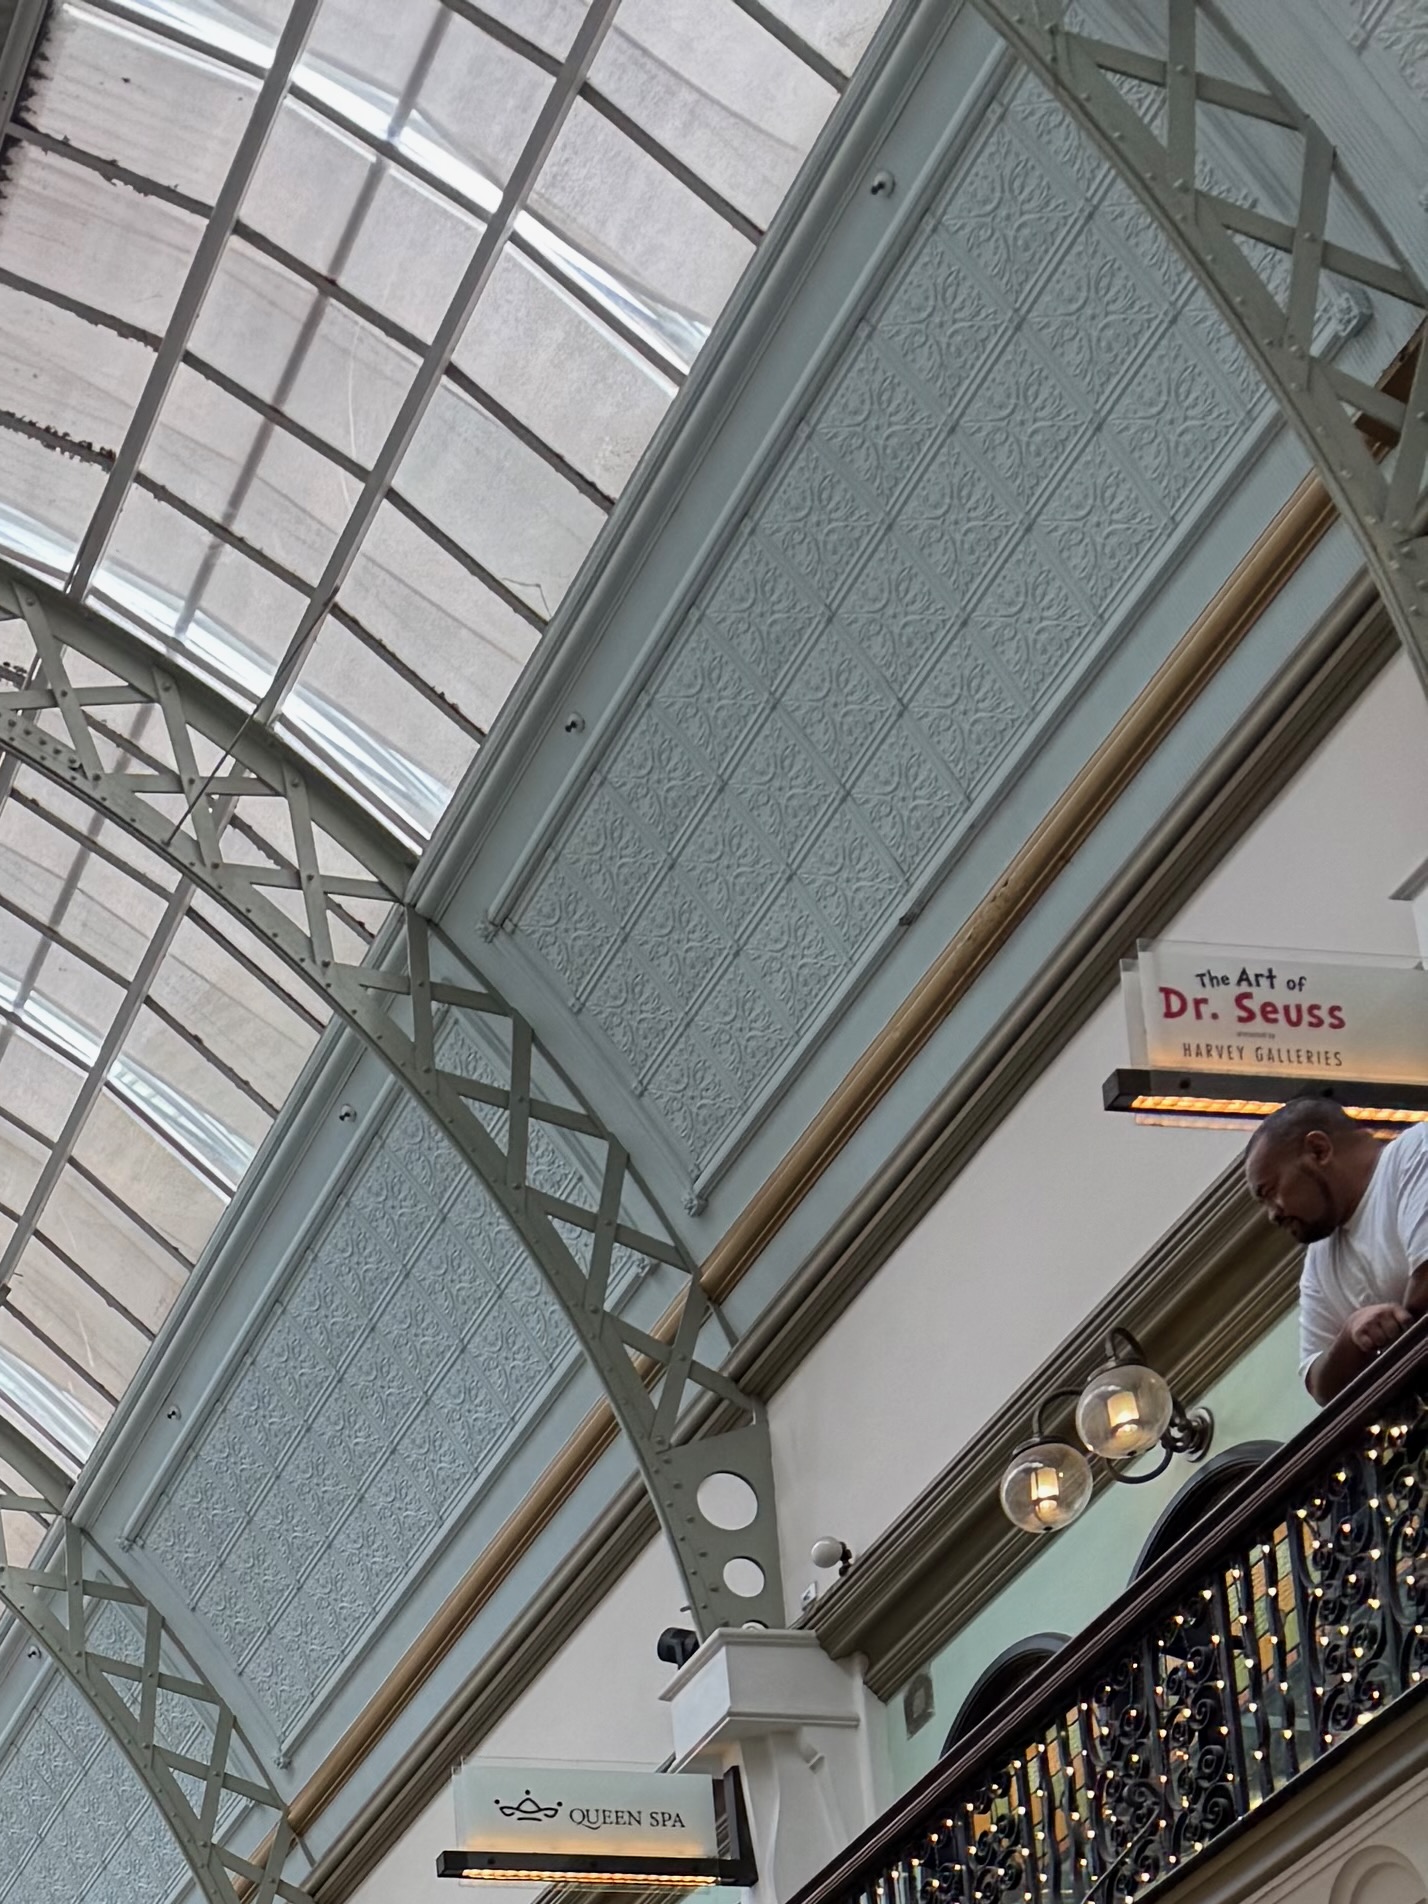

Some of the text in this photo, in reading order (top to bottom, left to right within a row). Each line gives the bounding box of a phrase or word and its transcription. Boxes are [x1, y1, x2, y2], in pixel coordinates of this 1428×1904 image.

[1196, 966, 1307, 992] The Art of
[1159, 986, 1346, 1030] Dr. Seuss
[1182, 1042, 1344, 1067] HARVEY GALLERIES
[569, 1807, 686, 1830] QUEEN SPA
